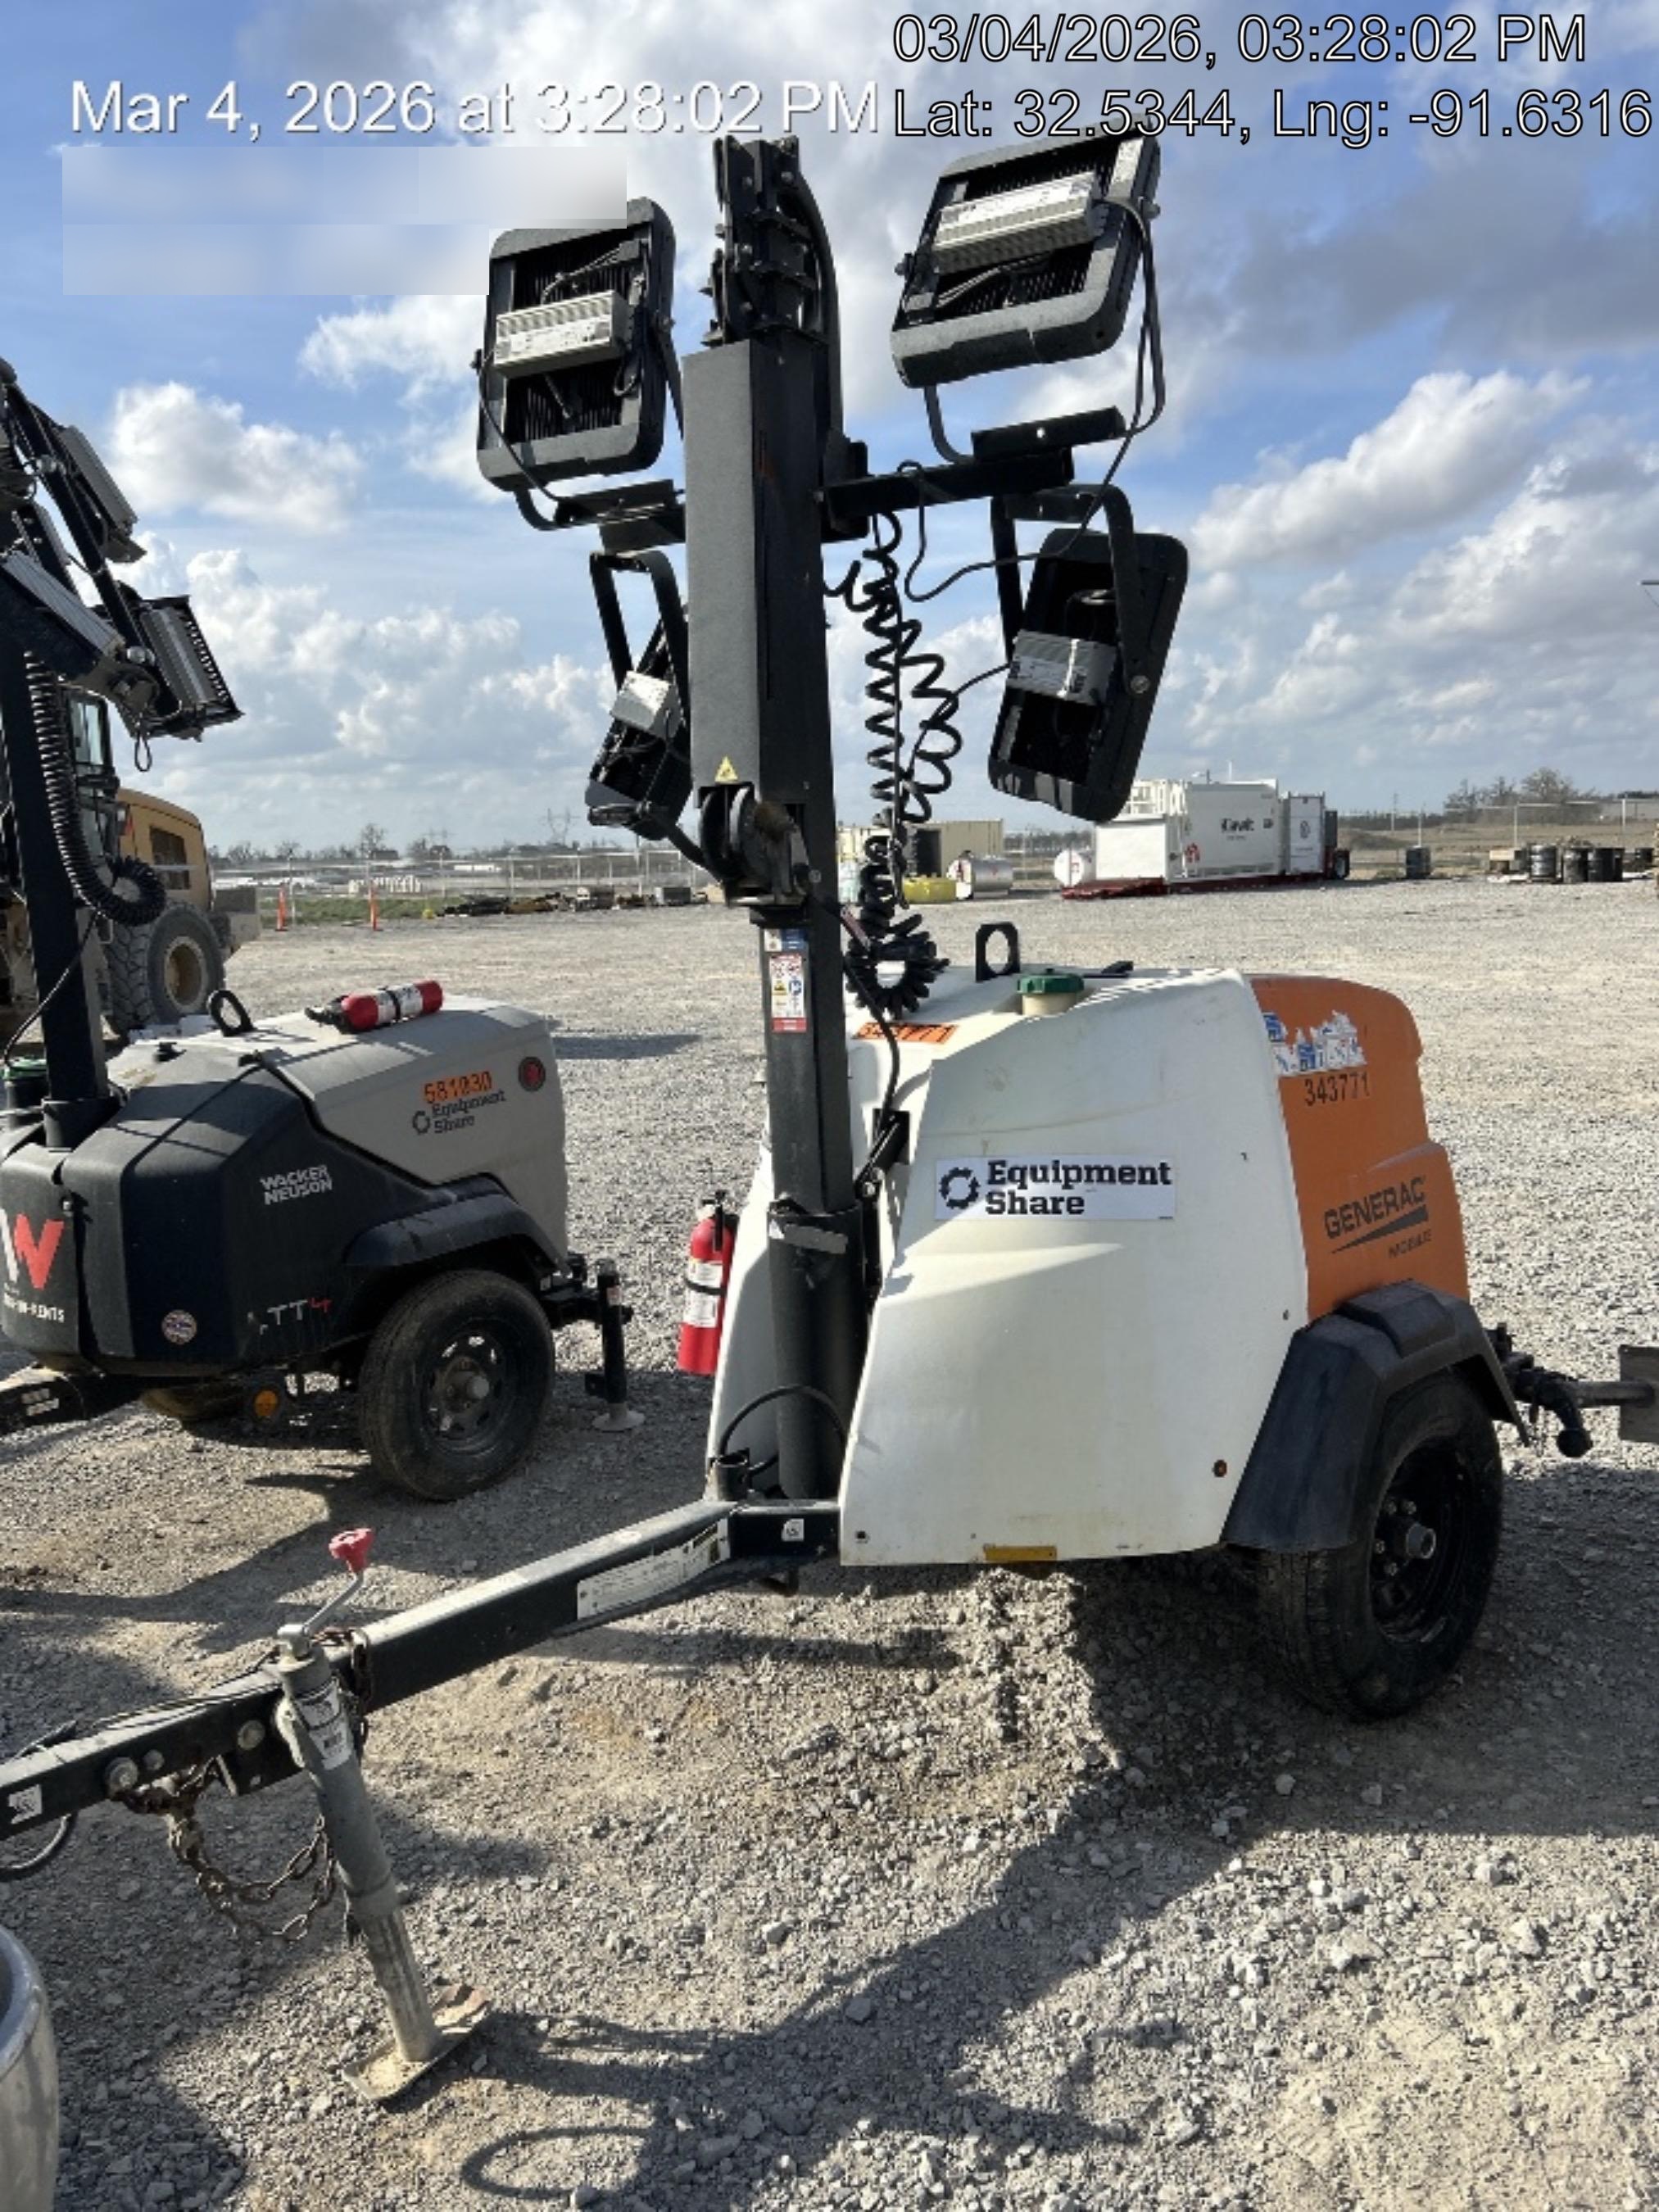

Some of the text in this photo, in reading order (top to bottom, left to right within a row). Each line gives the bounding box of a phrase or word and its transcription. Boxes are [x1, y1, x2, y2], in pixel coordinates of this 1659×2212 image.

[1304, 1072, 1371, 1106] 343771
[260, 1165, 329, 1191] WACKER
[986, 1159, 1172, 1190] Equipment
[264, 1180, 333, 1205] NEUSON
[985, 1190, 1085, 1214] Share
[1324, 1176, 1426, 1240] GENERAC
